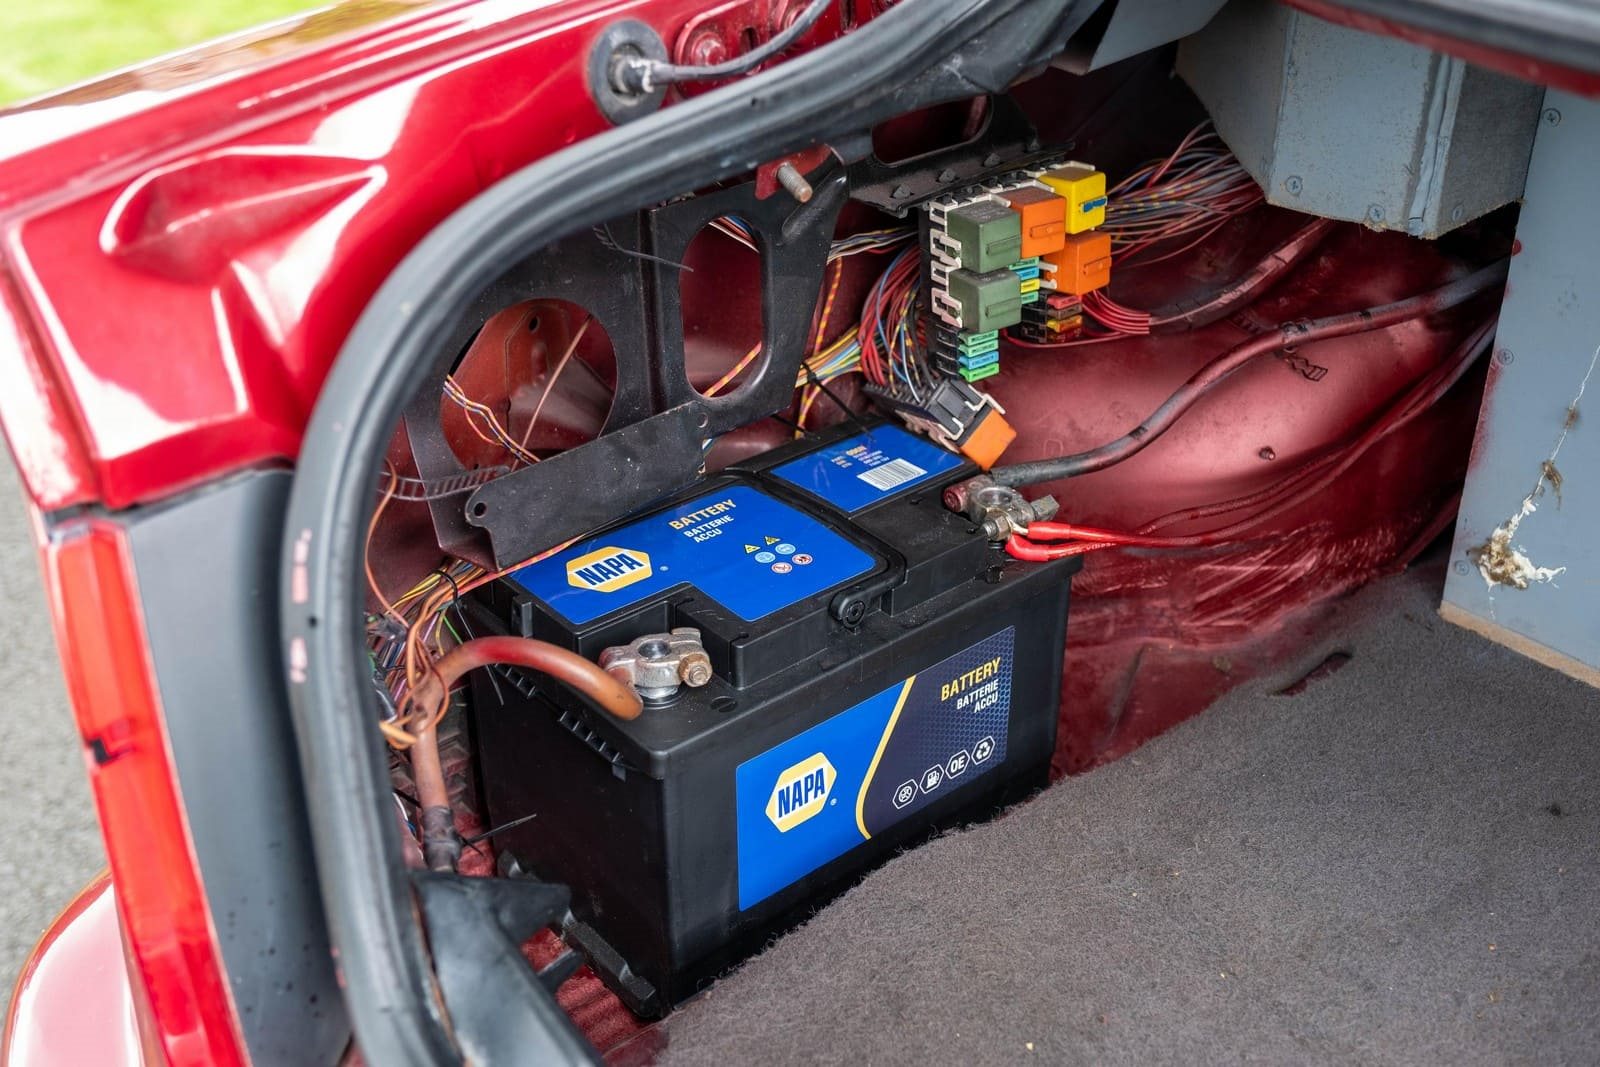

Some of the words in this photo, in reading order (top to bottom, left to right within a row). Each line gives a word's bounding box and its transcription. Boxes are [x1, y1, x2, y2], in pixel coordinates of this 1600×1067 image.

[668, 498, 737, 530] BATTERY
[683, 515, 734, 538] BATTERIE
[693, 528, 723, 543] ACCU
[575, 553, 644, 586] NAPA
[940, 656, 1001, 701] BATTERY
[956, 679, 999, 710] BATTERIE
[973, 693, 998, 713] ACCU
[950, 756, 966, 773] OE
[777, 767, 825, 818] NAPA
